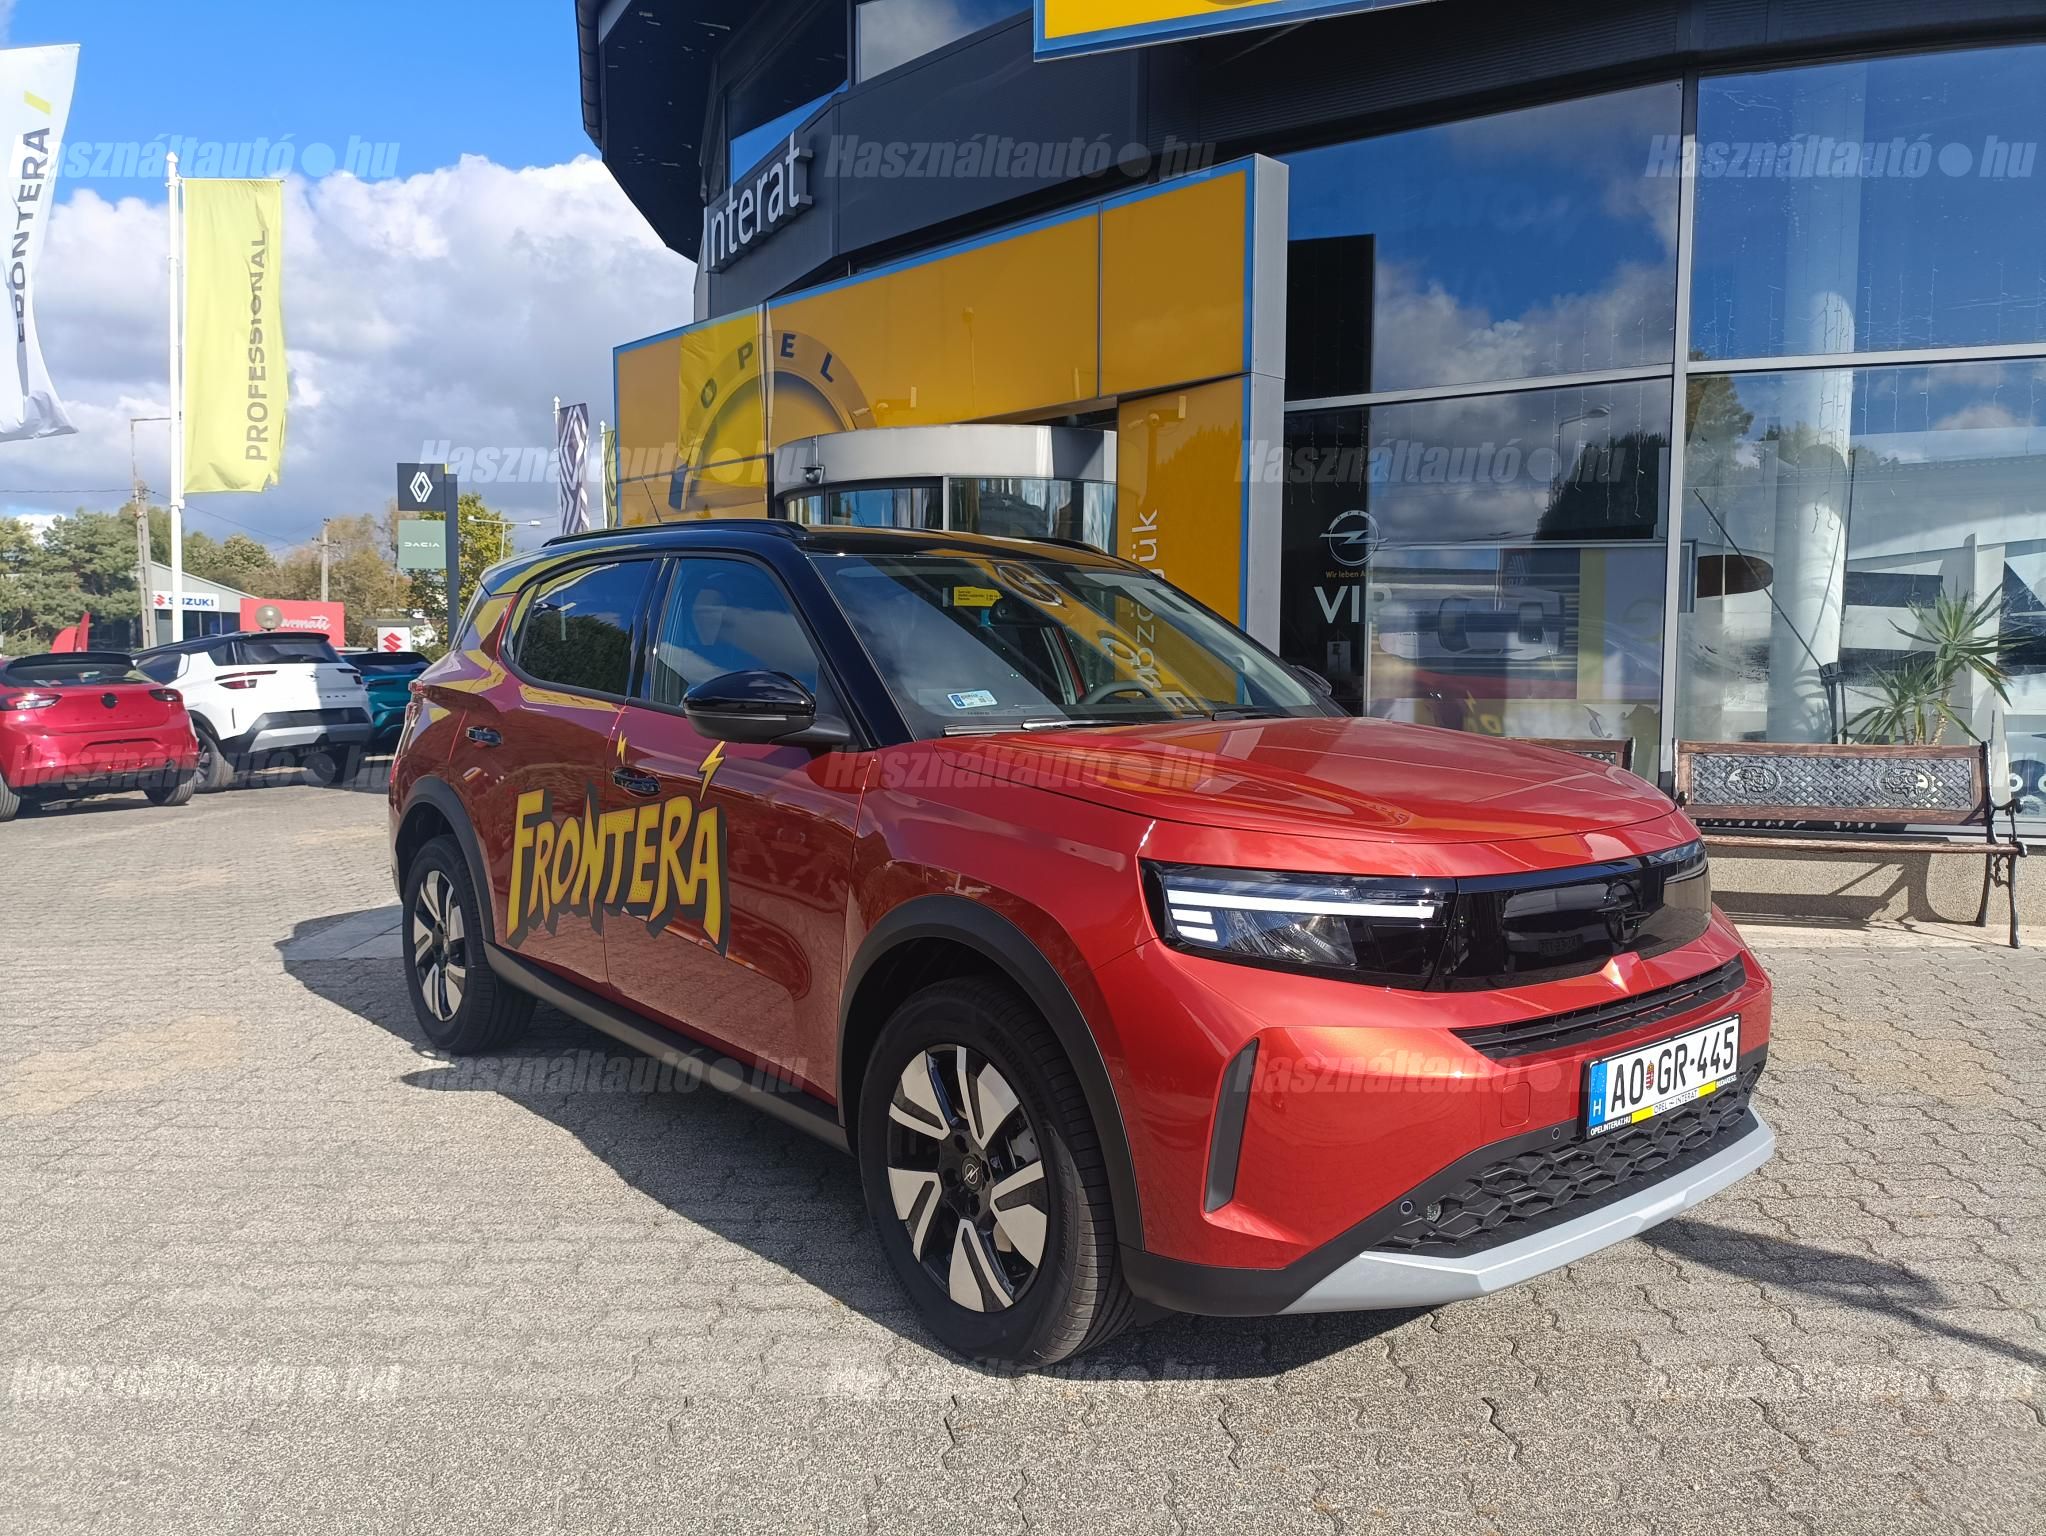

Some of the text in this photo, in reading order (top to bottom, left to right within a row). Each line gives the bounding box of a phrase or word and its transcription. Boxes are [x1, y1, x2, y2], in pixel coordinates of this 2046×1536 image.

[703, 131, 800, 272] Interat
[244, 230, 268, 461] PROFESSIONAL
[700, 333, 834, 408] OPEL
[168, 596, 214, 607] SZUKI
[1314, 584, 1393, 624] VIP
[506, 783, 726, 952] FRONTERA
[1593, 1098, 1602, 1117] H
[1611, 1058, 1644, 1112] AO
